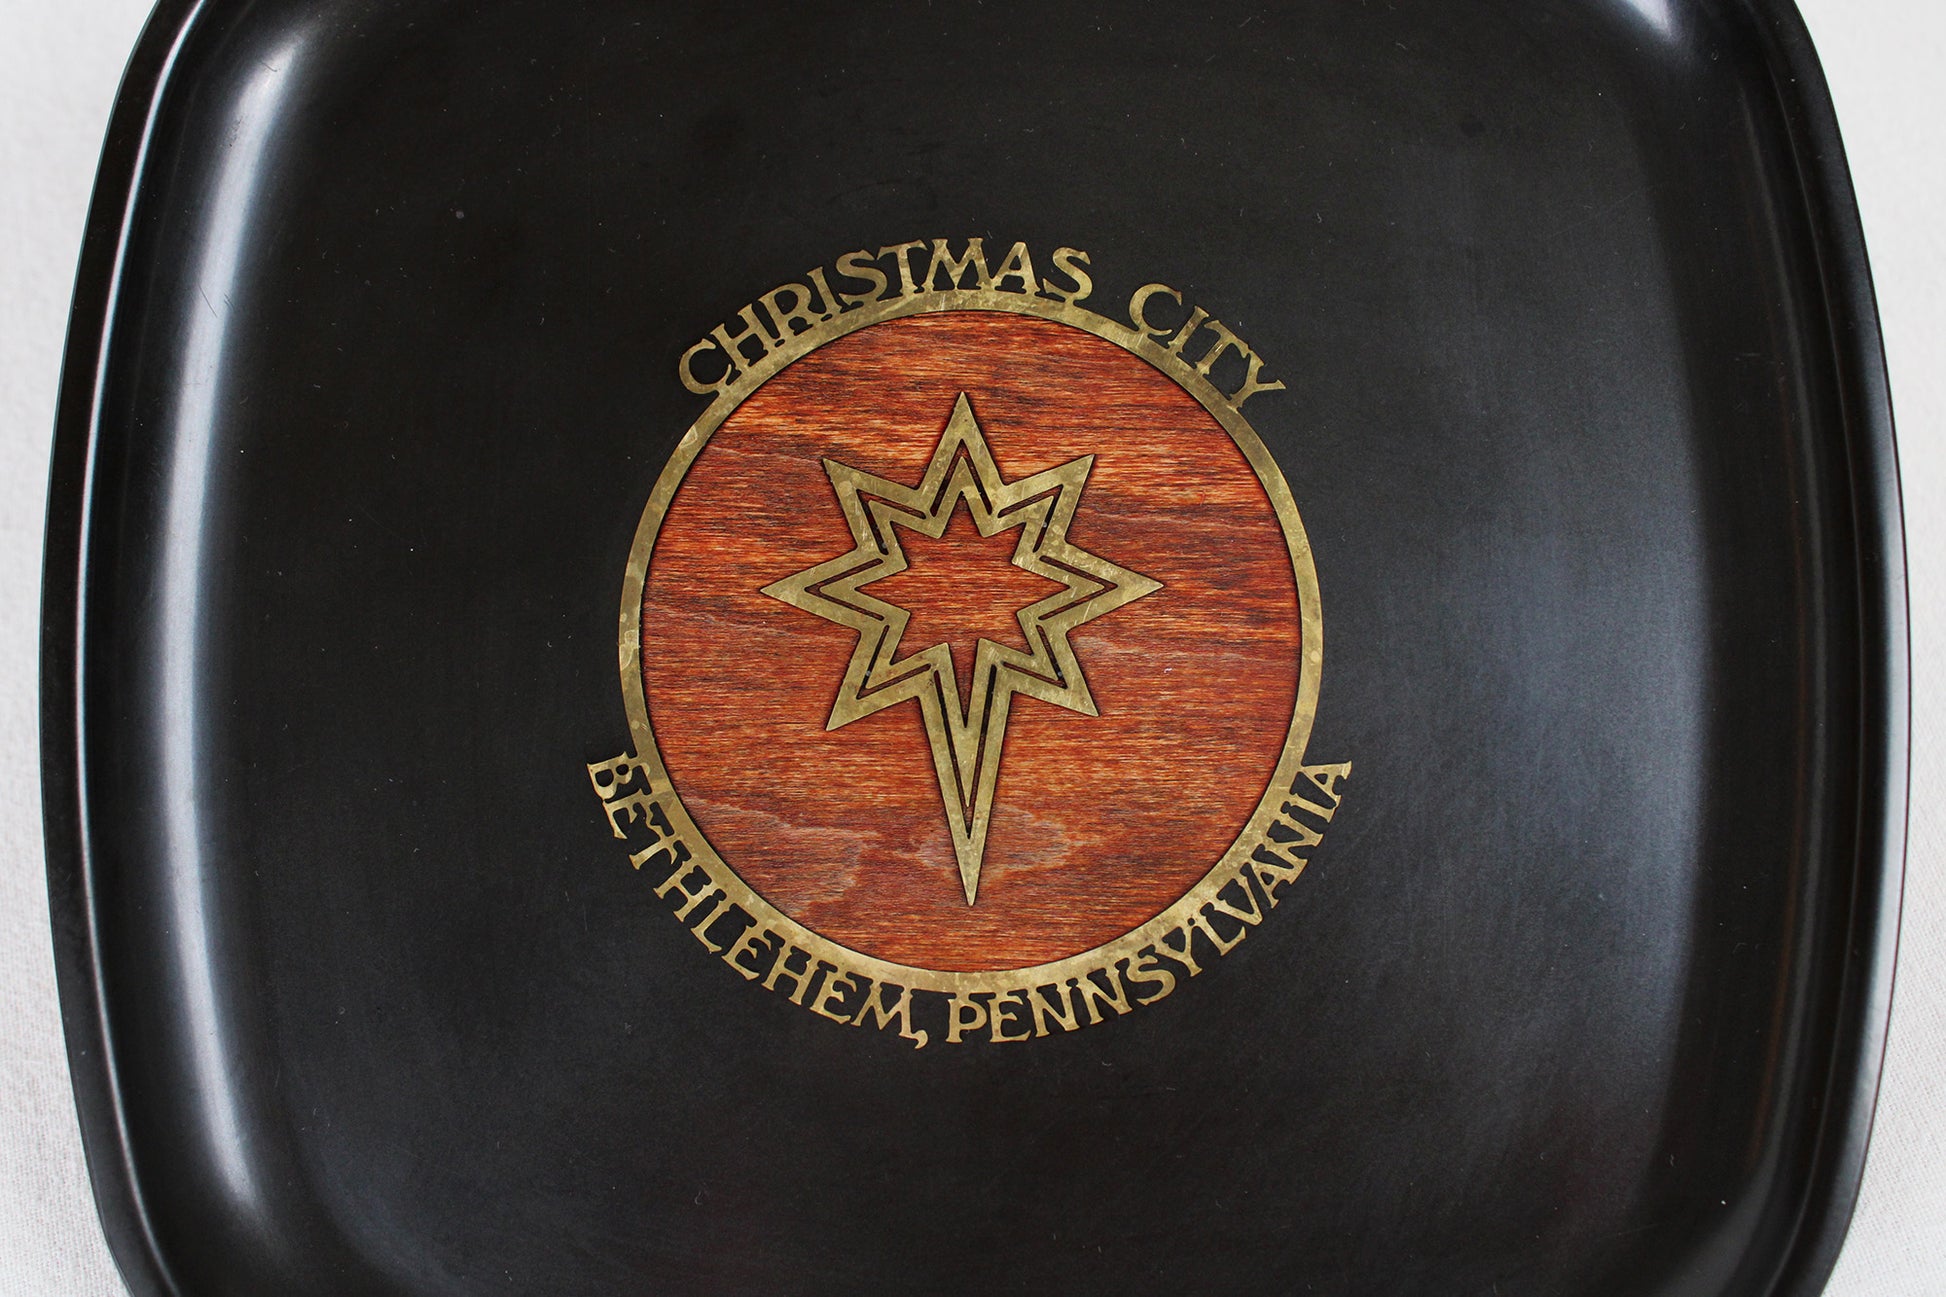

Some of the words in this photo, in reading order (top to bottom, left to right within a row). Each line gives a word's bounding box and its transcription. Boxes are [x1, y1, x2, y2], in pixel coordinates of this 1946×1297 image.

[678, 237, 1092, 396] CHRISTMAS
[1129, 283, 1286, 408] CITY
[586, 752, 928, 1049] BETHLEHEM,
[945, 761, 1352, 1043] PENNSYLVANIA
